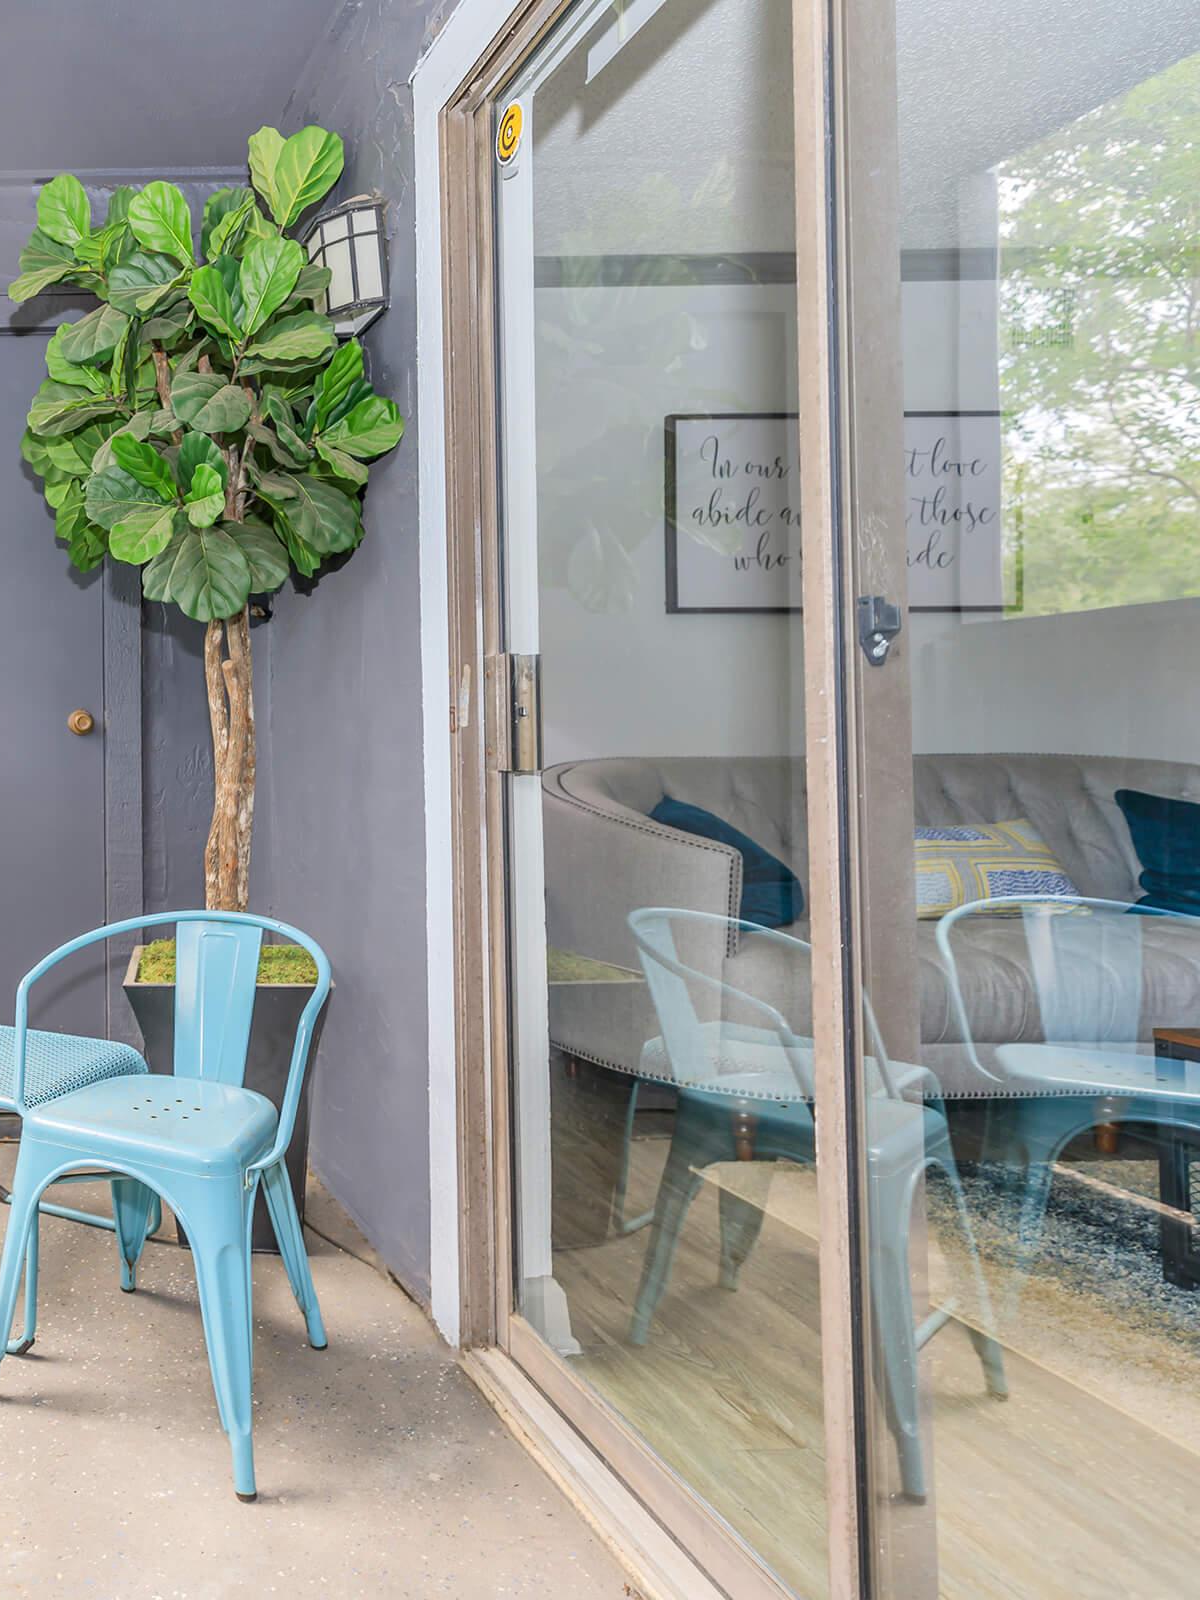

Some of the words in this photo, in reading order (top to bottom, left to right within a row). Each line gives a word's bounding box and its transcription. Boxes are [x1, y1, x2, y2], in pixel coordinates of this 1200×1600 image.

[700, 435, 737, 479] In
[745, 455, 790, 479] our
[931, 437, 988, 478] love
[691, 486, 774, 527] abide
[911, 485, 997, 533] those
[733, 530, 792, 571] who
